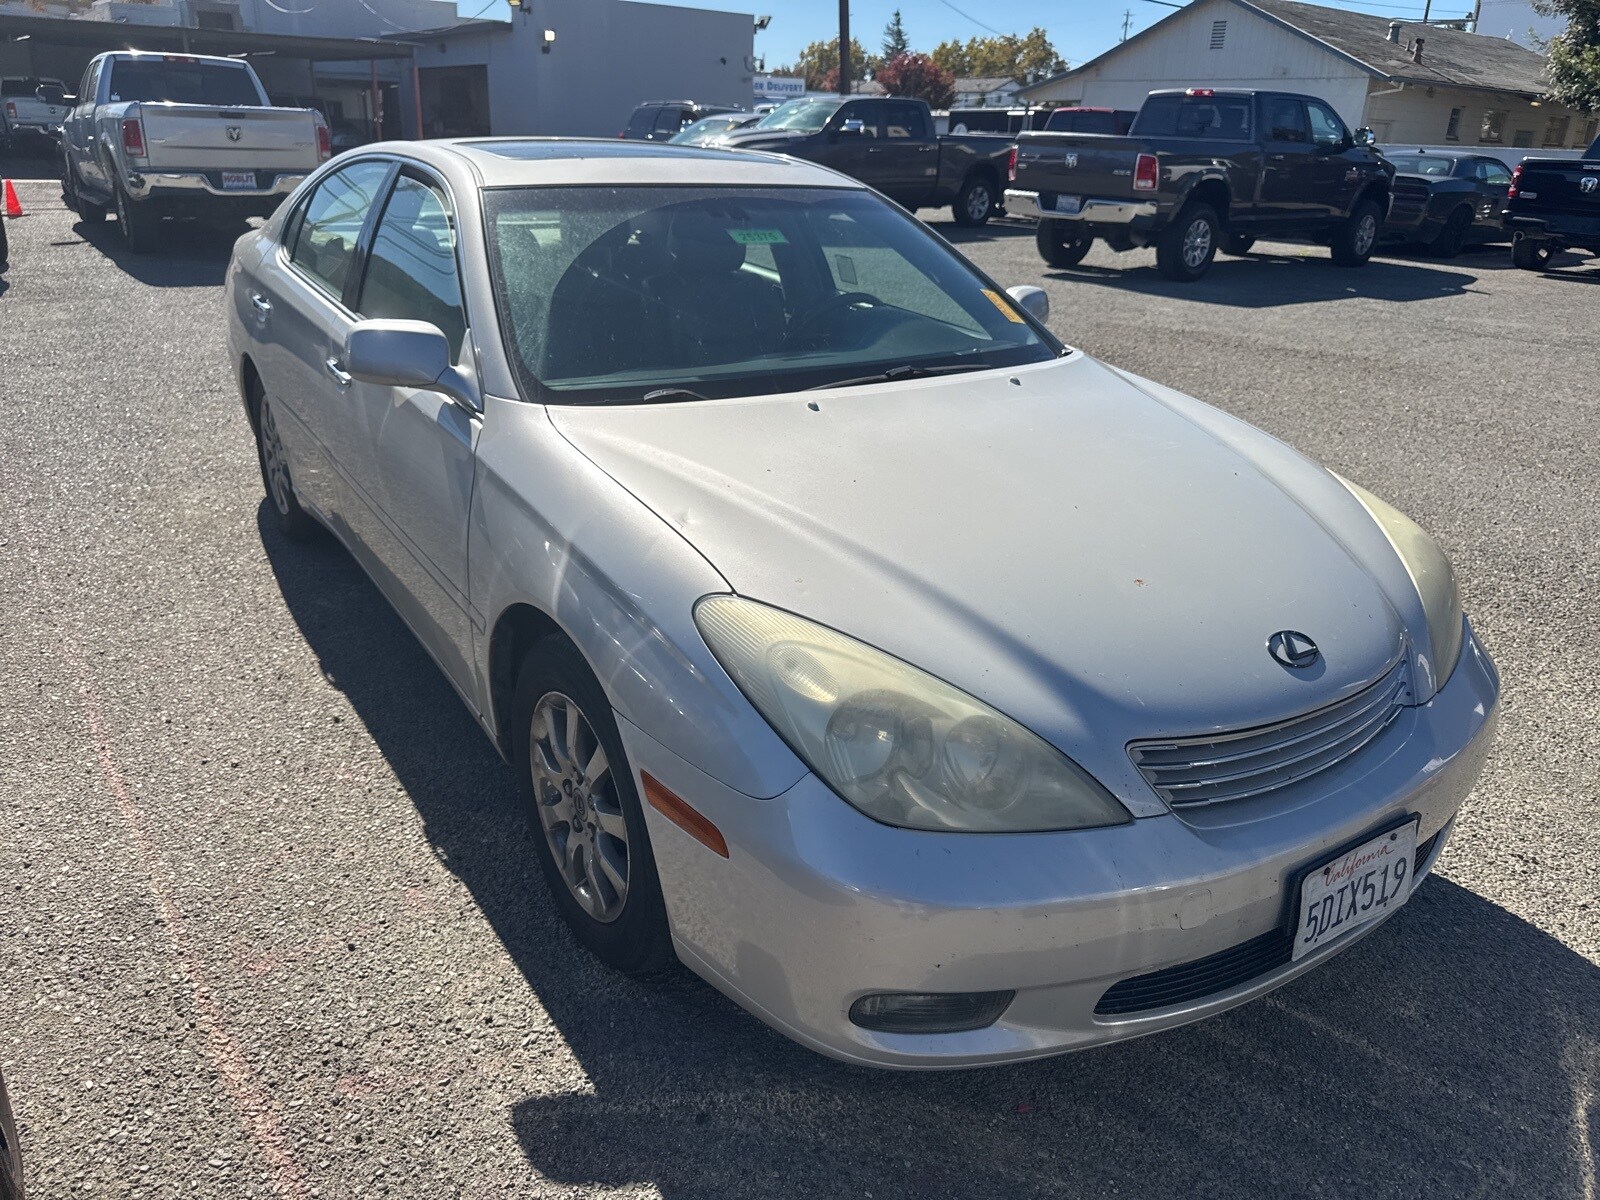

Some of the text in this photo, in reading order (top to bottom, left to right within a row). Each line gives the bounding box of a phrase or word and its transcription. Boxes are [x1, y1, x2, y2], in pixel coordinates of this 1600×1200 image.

[766, 81, 803, 92] DELIVERY
[1324, 843, 1395, 887] California
[1304, 857, 1407, 943] 5DIX519
